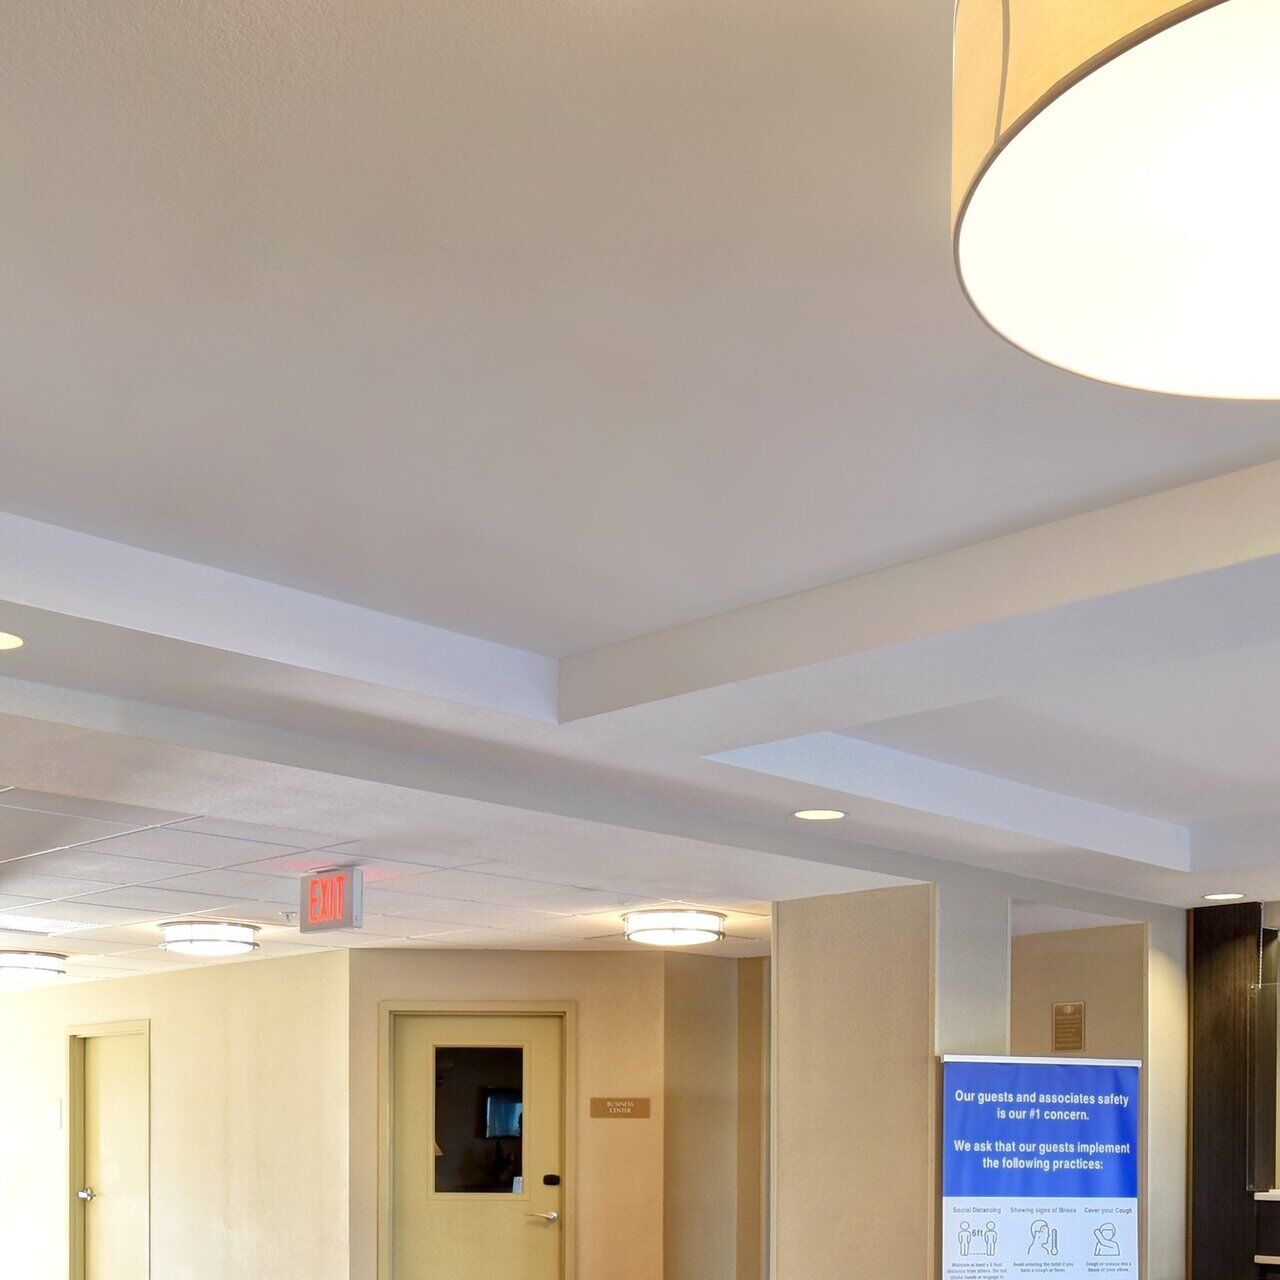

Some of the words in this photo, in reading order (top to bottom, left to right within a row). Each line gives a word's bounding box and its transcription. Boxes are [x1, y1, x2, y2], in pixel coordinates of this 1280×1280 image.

[308, 875, 345, 923] EXIT
[955, 1089, 975, 1102] Our
[978, 1092, 1013, 1105] guests
[1016, 1092, 1036, 1103] and
[1039, 1092, 1095, 1104] associates
[1098, 1094, 1129, 1107] safety
[997, 1107, 1006, 1119] is
[1008, 1109, 1027, 1119] our
[1029, 1108, 1040, 1119] #1
[1044, 1109, 1089, 1120] concern.
[953, 1139, 971, 1151] We
[973, 1140, 992, 1152] ask
[995, 1140, 1016, 1152] that
[1019, 1143, 1036, 1153] our
[1039, 1142, 1075, 1155] guests
[1077, 1142, 1130, 1156] implement
[982, 1157, 999, 1169] the
[1002, 1157, 1050, 1171] following
[1052, 1158, 1104, 1172] practices:
[972, 1206, 1001, 1214] Distancing
[1115, 1206, 1132, 1214] Cough
[972, 1229, 983, 1237] 6ft
